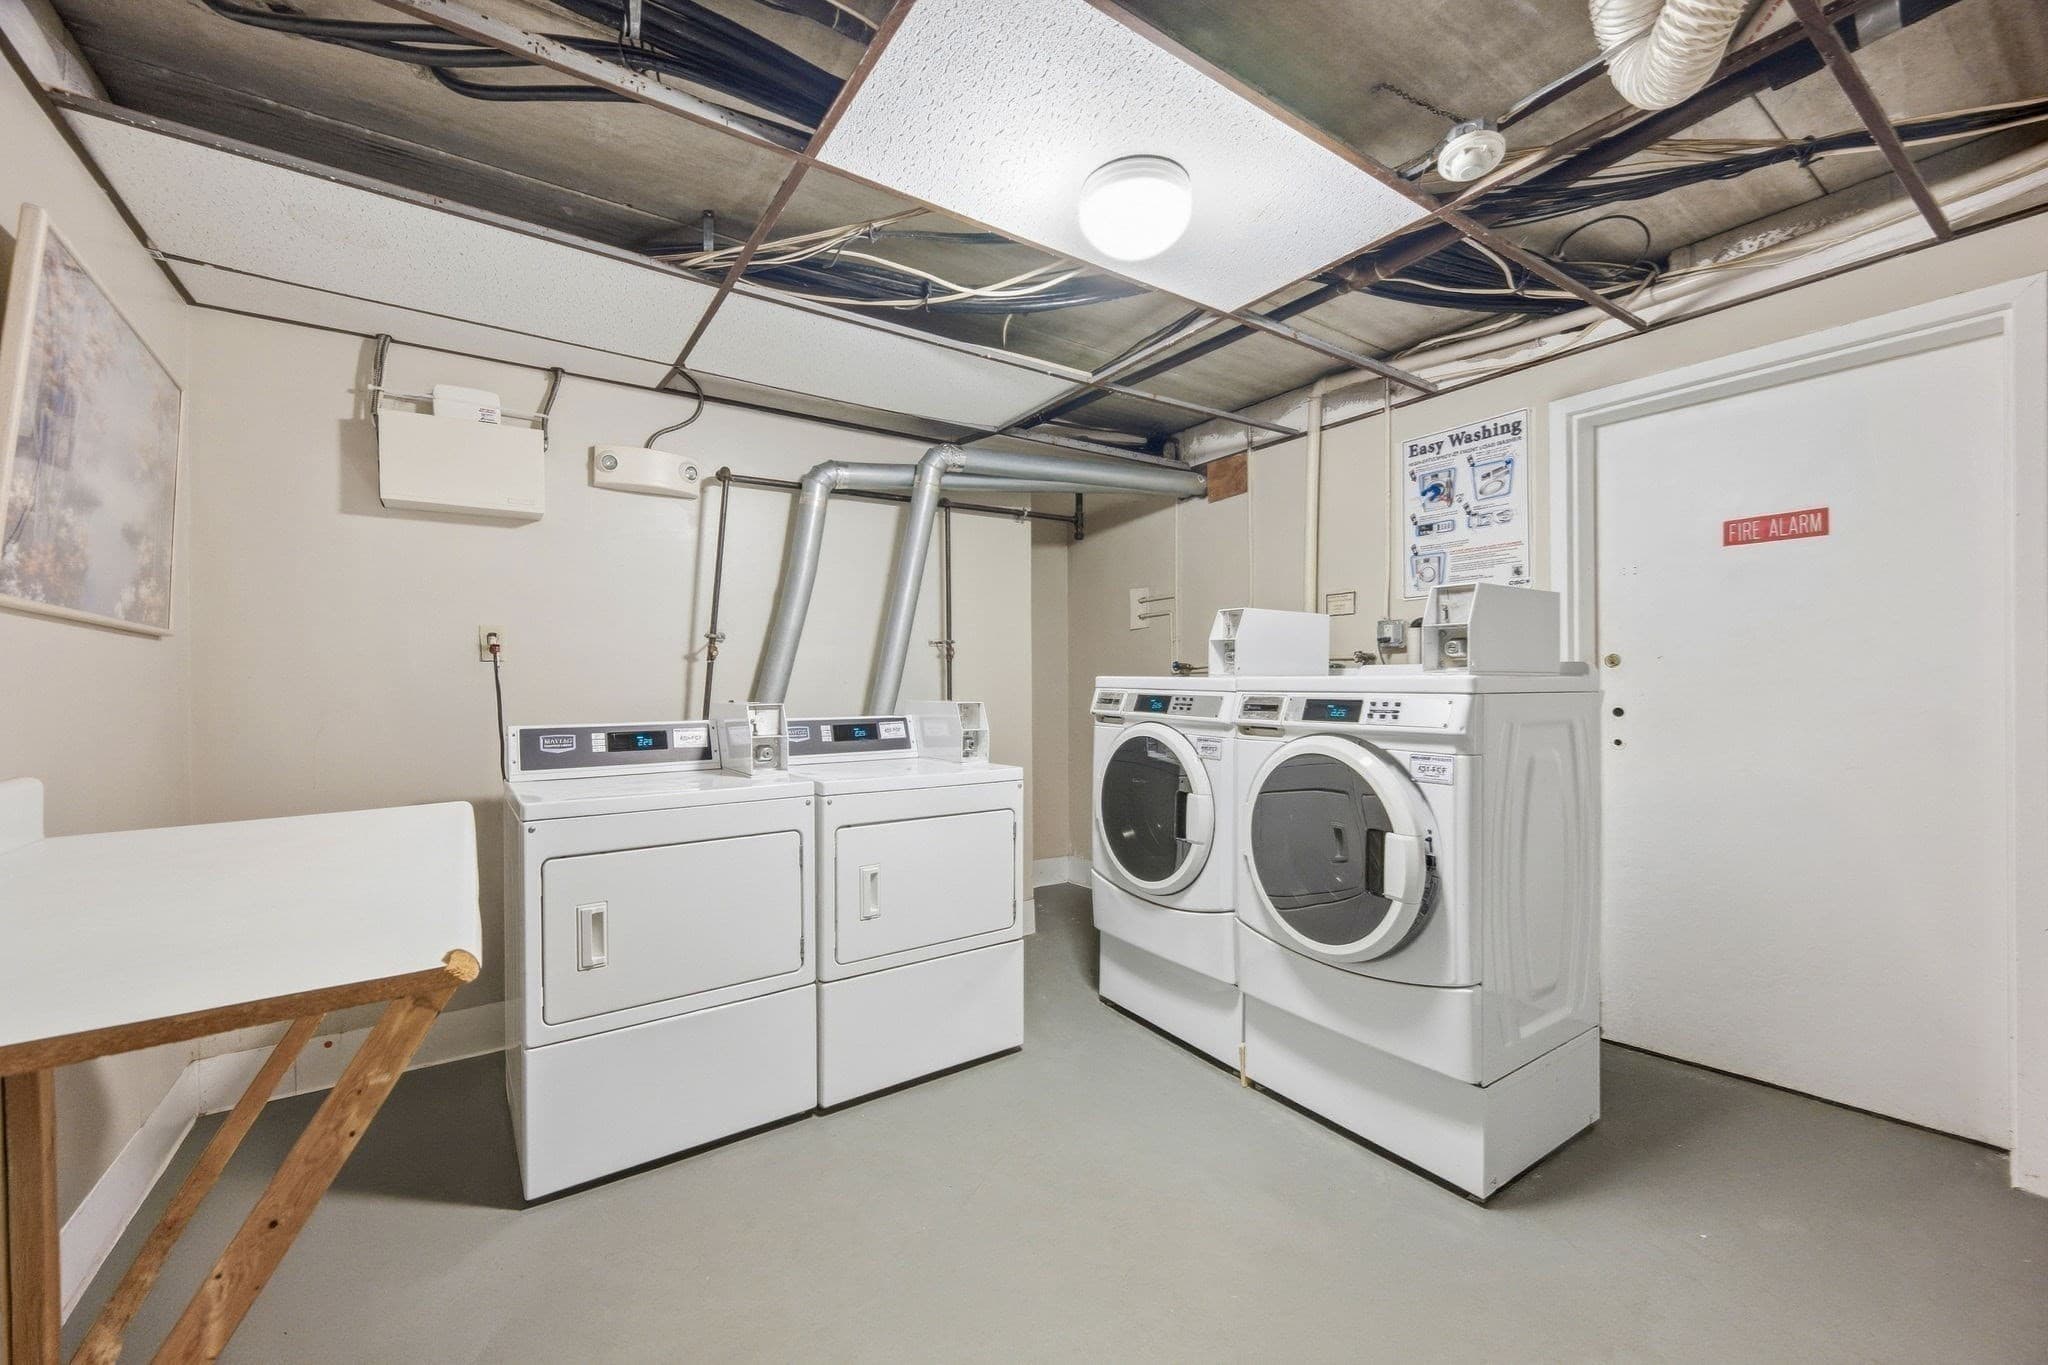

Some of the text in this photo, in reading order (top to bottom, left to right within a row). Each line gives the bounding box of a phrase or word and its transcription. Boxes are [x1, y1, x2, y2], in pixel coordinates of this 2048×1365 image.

[1408, 420, 1522, 458] Easy Washing
[1728, 512, 1822, 542] FIRE ALARM
[544, 737, 573, 745] MAYTAG
